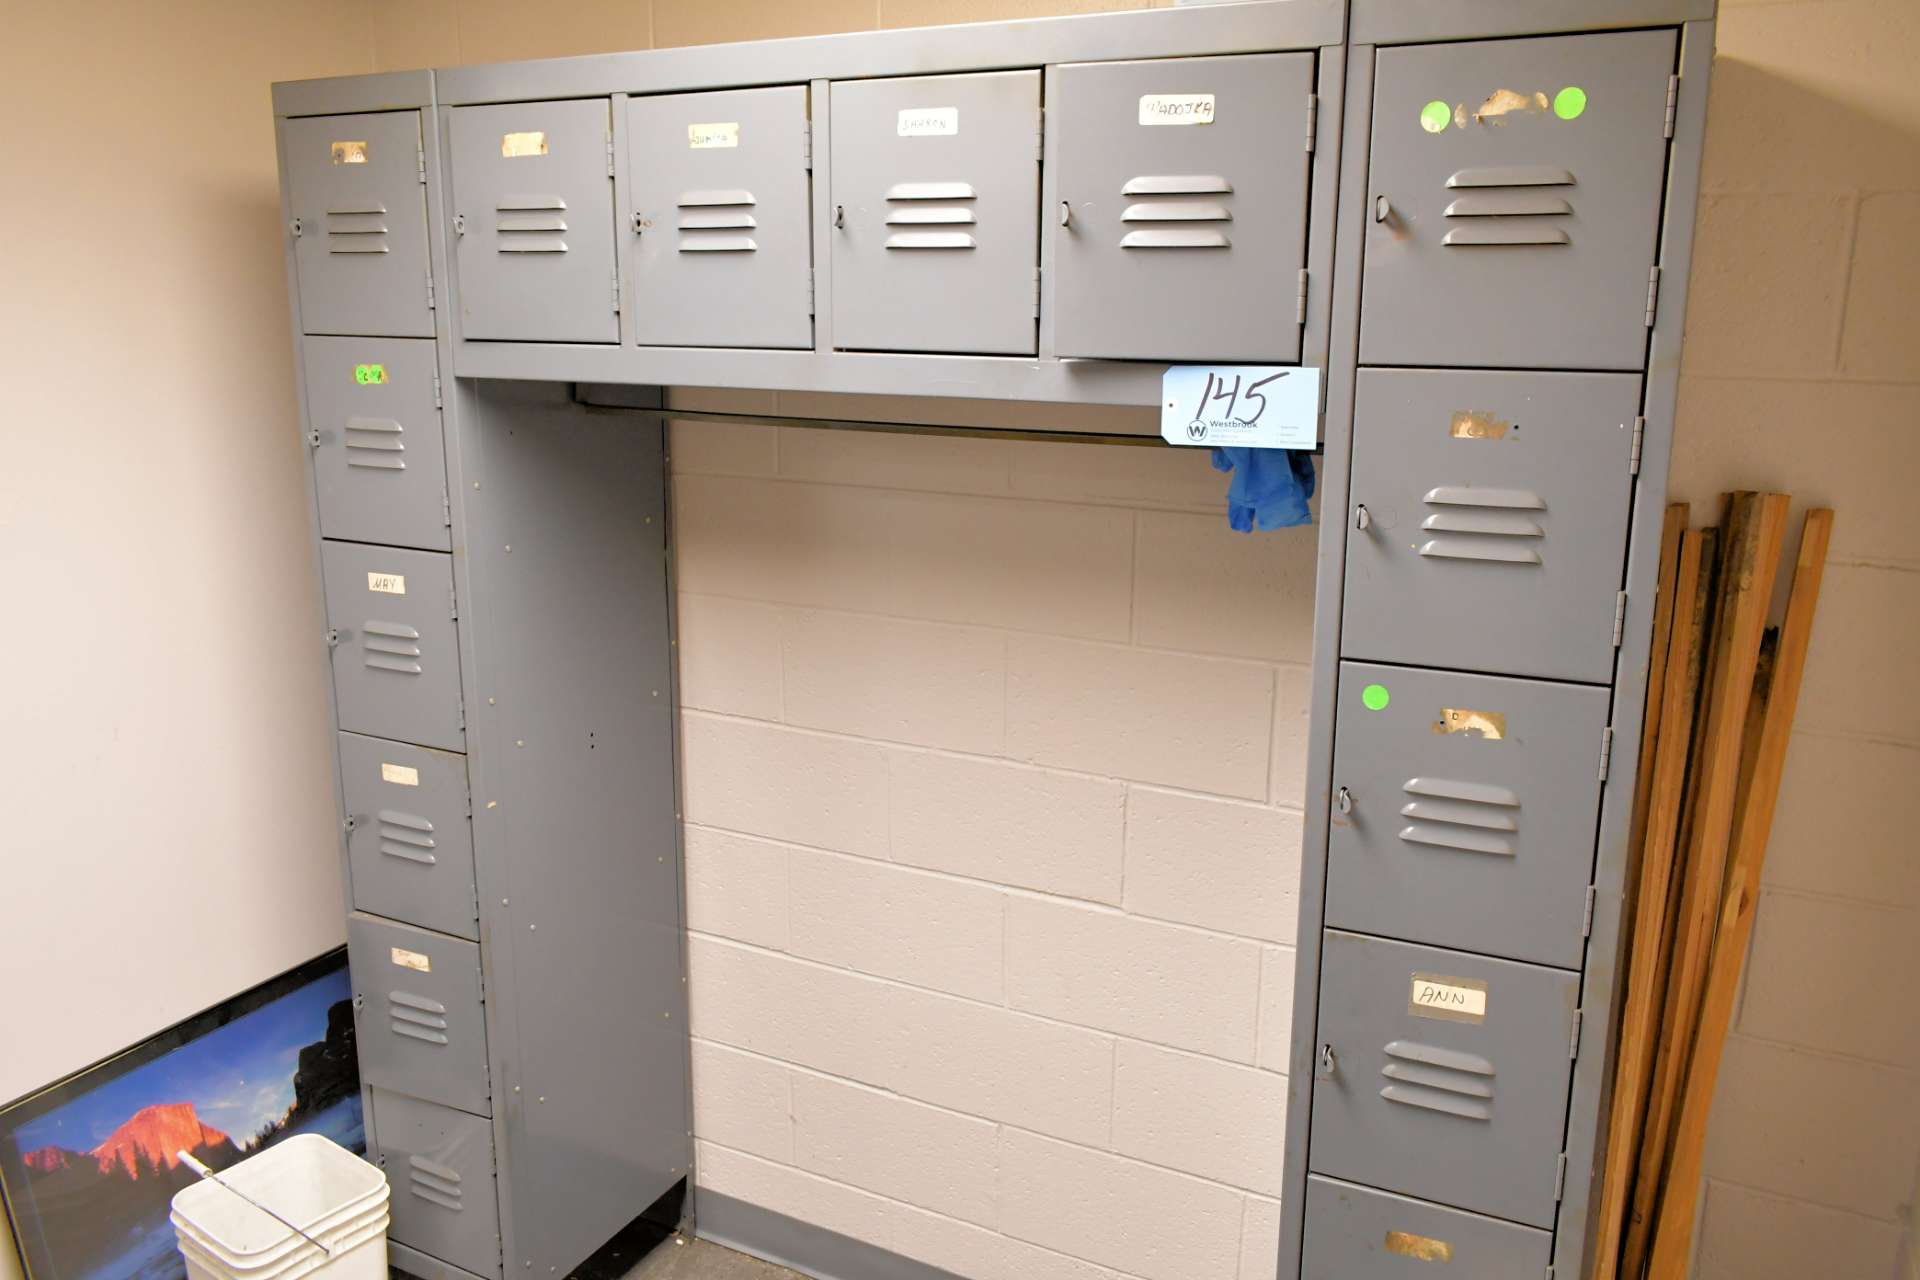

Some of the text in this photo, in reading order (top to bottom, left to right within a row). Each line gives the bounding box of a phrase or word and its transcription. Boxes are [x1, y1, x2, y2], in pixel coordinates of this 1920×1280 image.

[1195, 372, 1290, 424] 145
[1209, 420, 1258, 429] Westbrook
[1418, 985, 1465, 1005] ANN
